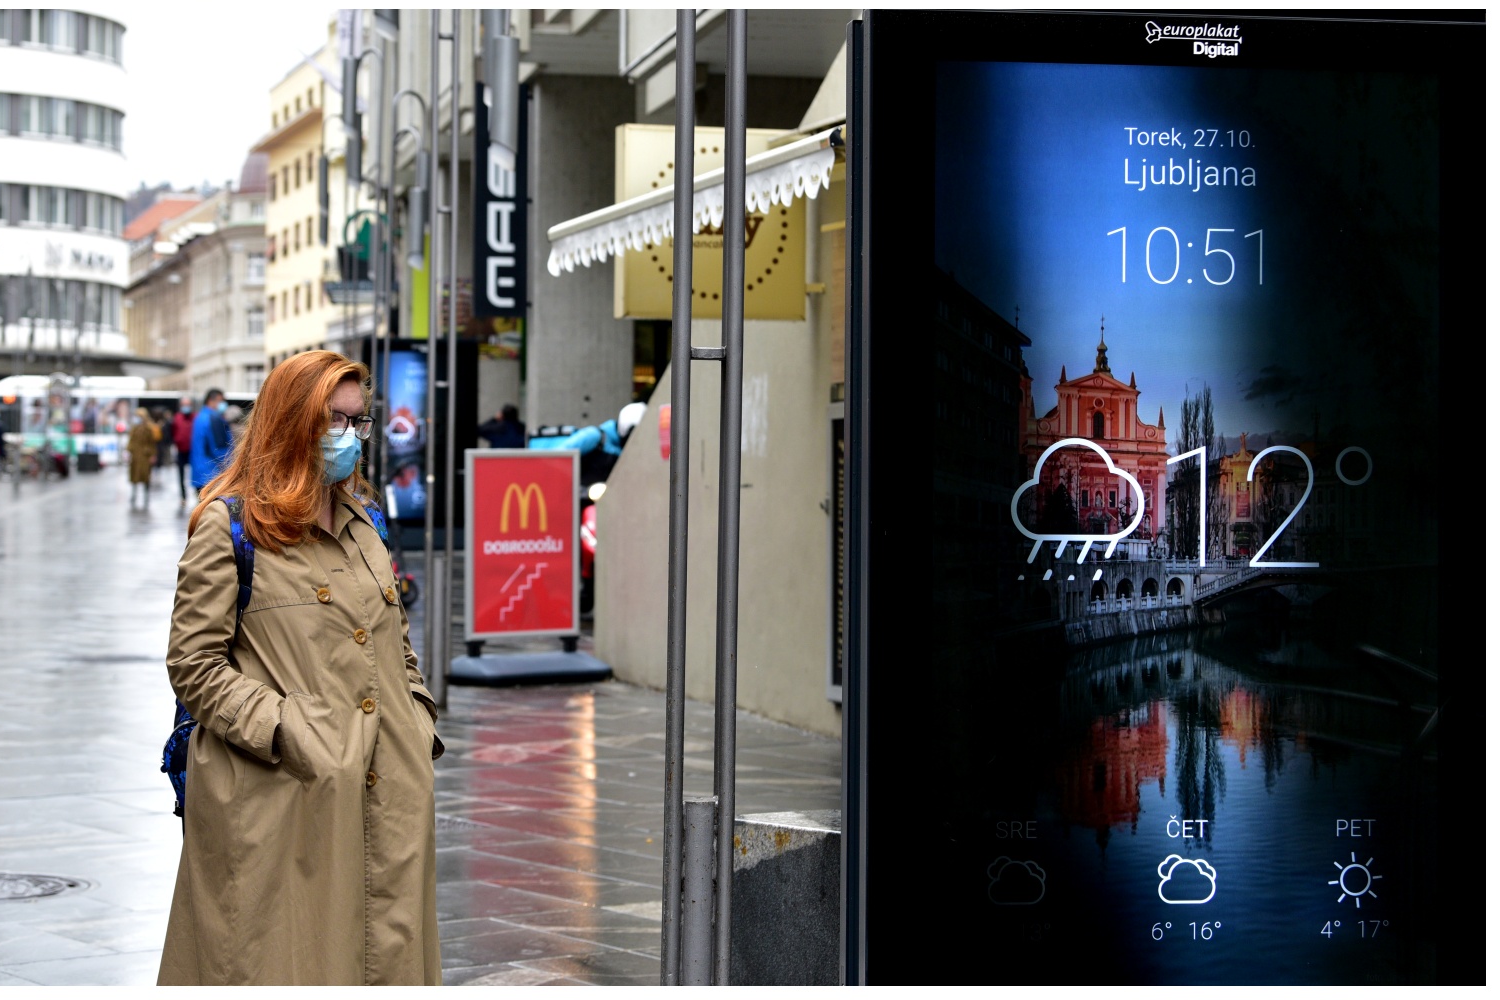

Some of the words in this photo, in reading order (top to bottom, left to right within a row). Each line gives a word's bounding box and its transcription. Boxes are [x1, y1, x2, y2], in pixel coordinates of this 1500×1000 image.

[1163, 23, 1240, 39] europlakat
[1193, 41, 1239, 59] Digital
[1124, 127, 1187, 150] Torek,
[1193, 128, 1256, 148] 27.10.
[1124, 157, 1257, 193] Ljubljana
[1106, 226, 1264, 286] 10:51
[483, 536, 563, 555] DOBRODOŠLI
[994, 820, 1038, 840] SRE
[1166, 814, 1208, 839] ČET
[1336, 818, 1376, 838] PET
[1151, 921, 1173, 941] 6°
[1188, 921, 1222, 940] 16°
[1320, 920, 1341, 940] 4°
[1357, 919, 1390, 939] 17°
